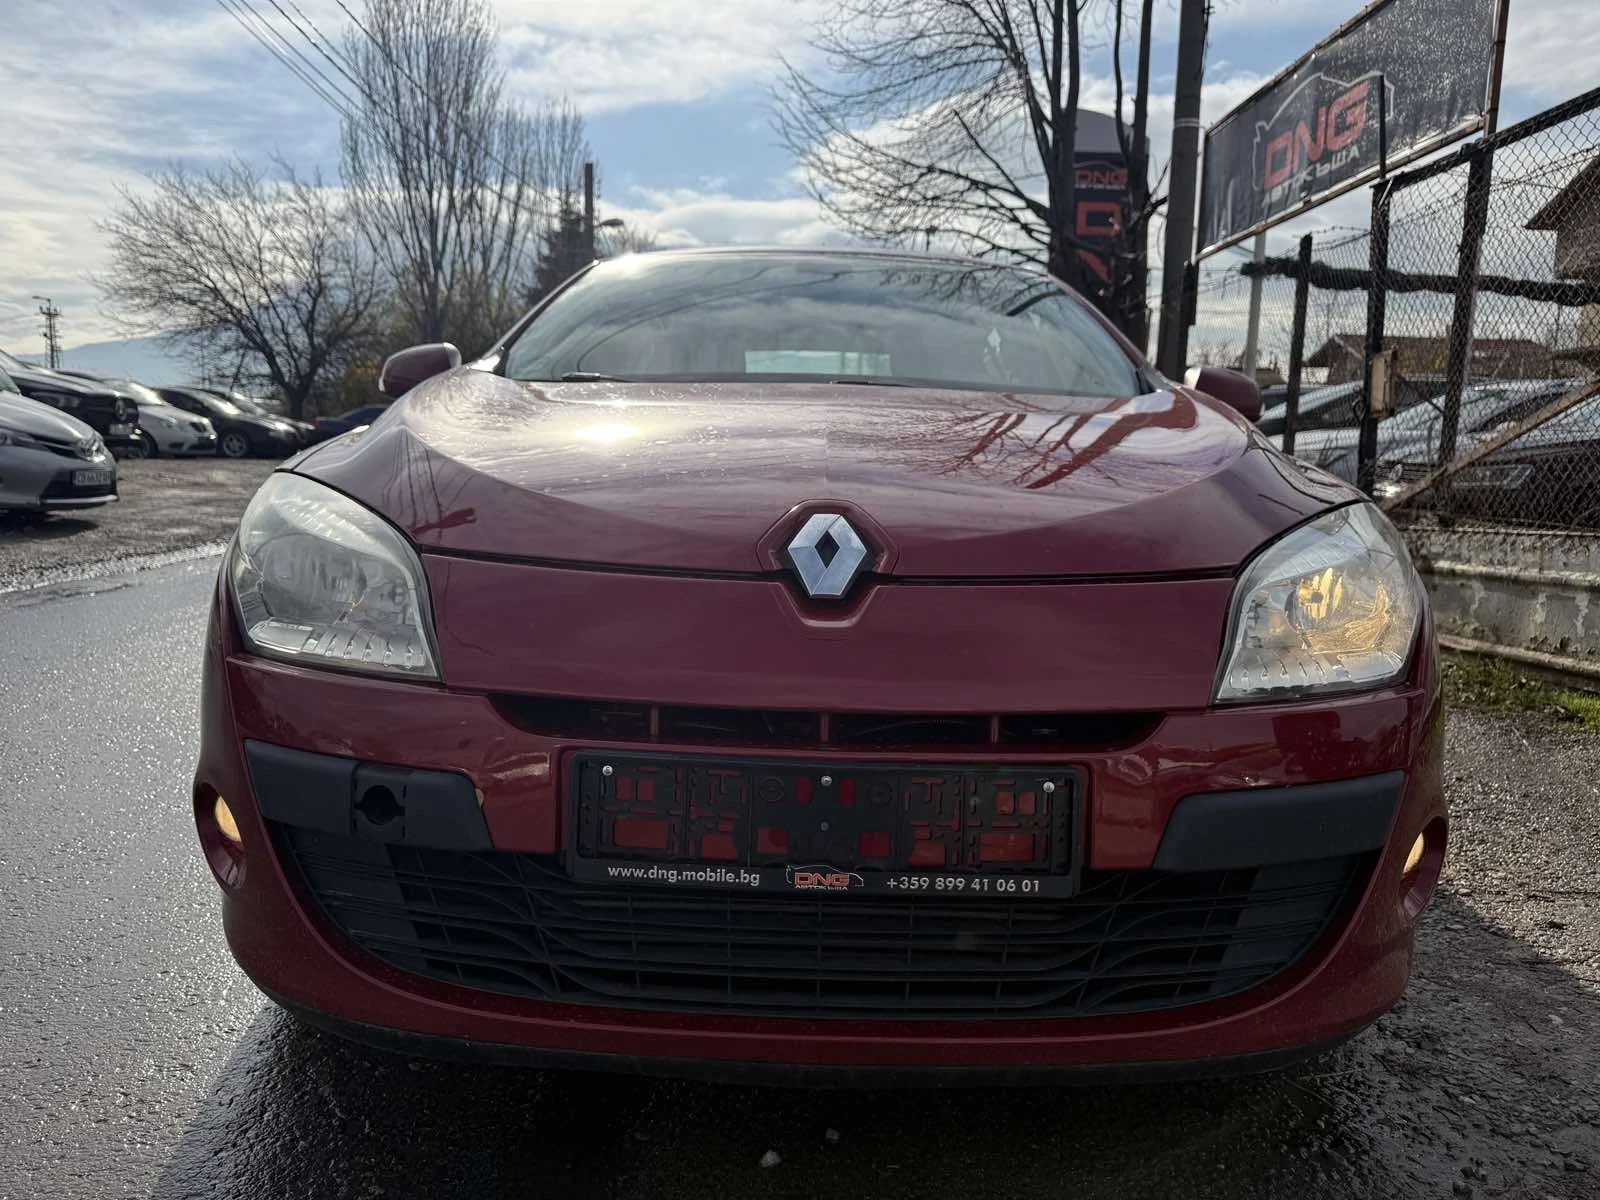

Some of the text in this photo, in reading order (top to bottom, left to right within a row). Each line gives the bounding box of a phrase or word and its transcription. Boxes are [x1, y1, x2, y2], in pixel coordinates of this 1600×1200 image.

[1264, 80, 1368, 189] DNG
[607, 865, 760, 887] www.dng.mobile.bg
[794, 872, 850, 887] DNG
[886, 876, 1040, 892] +359 899 41 06 01
